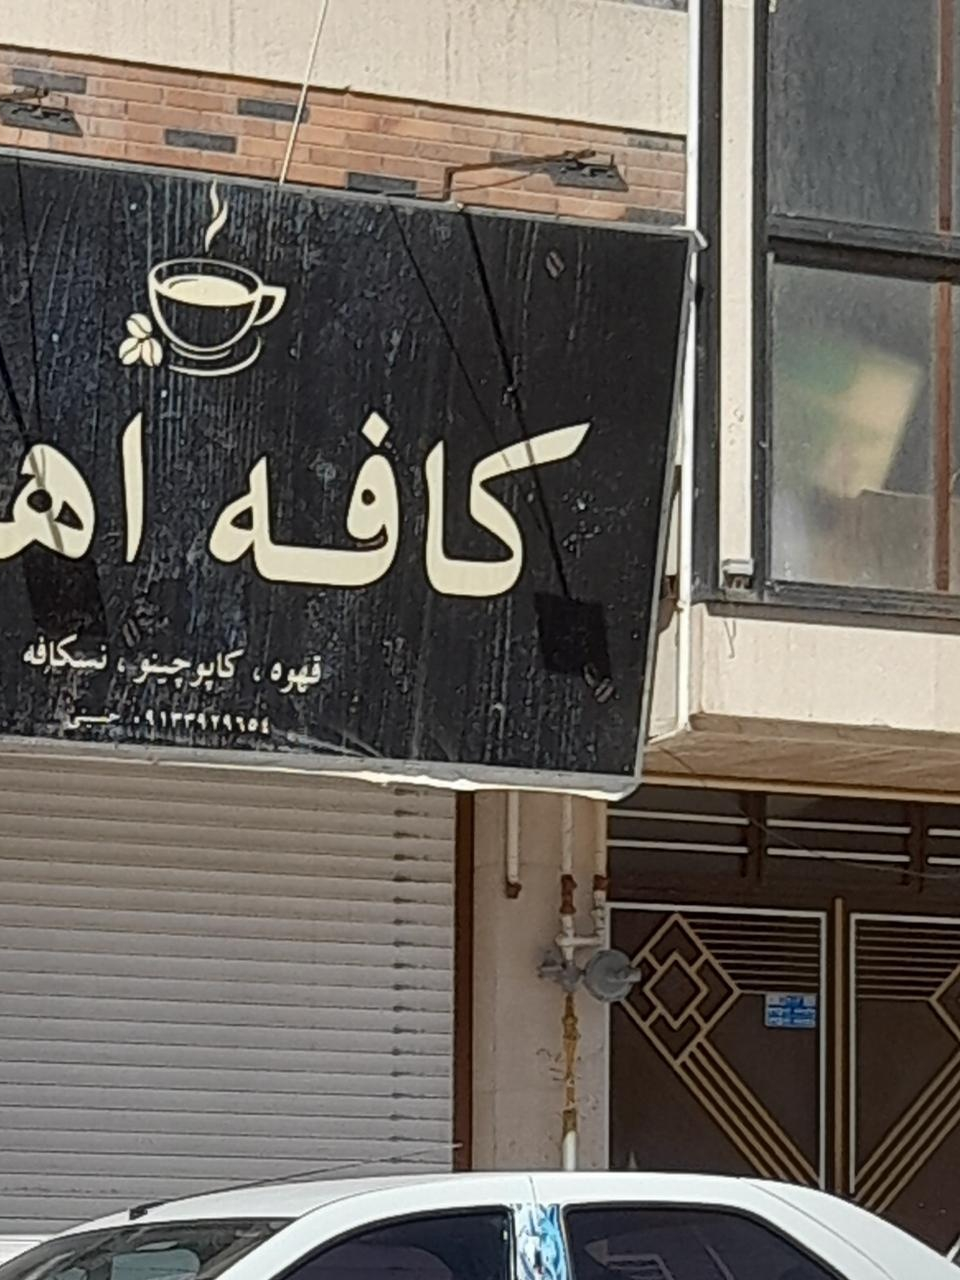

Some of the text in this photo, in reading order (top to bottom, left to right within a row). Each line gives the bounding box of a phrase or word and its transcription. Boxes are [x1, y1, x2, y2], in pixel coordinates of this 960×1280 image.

[208, 411, 590, 598] کافه
[23, 633, 108, 675] نسکافه
[132, 647, 245, 690] کاپوچینو
[269, 654, 323, 694] قهوه
